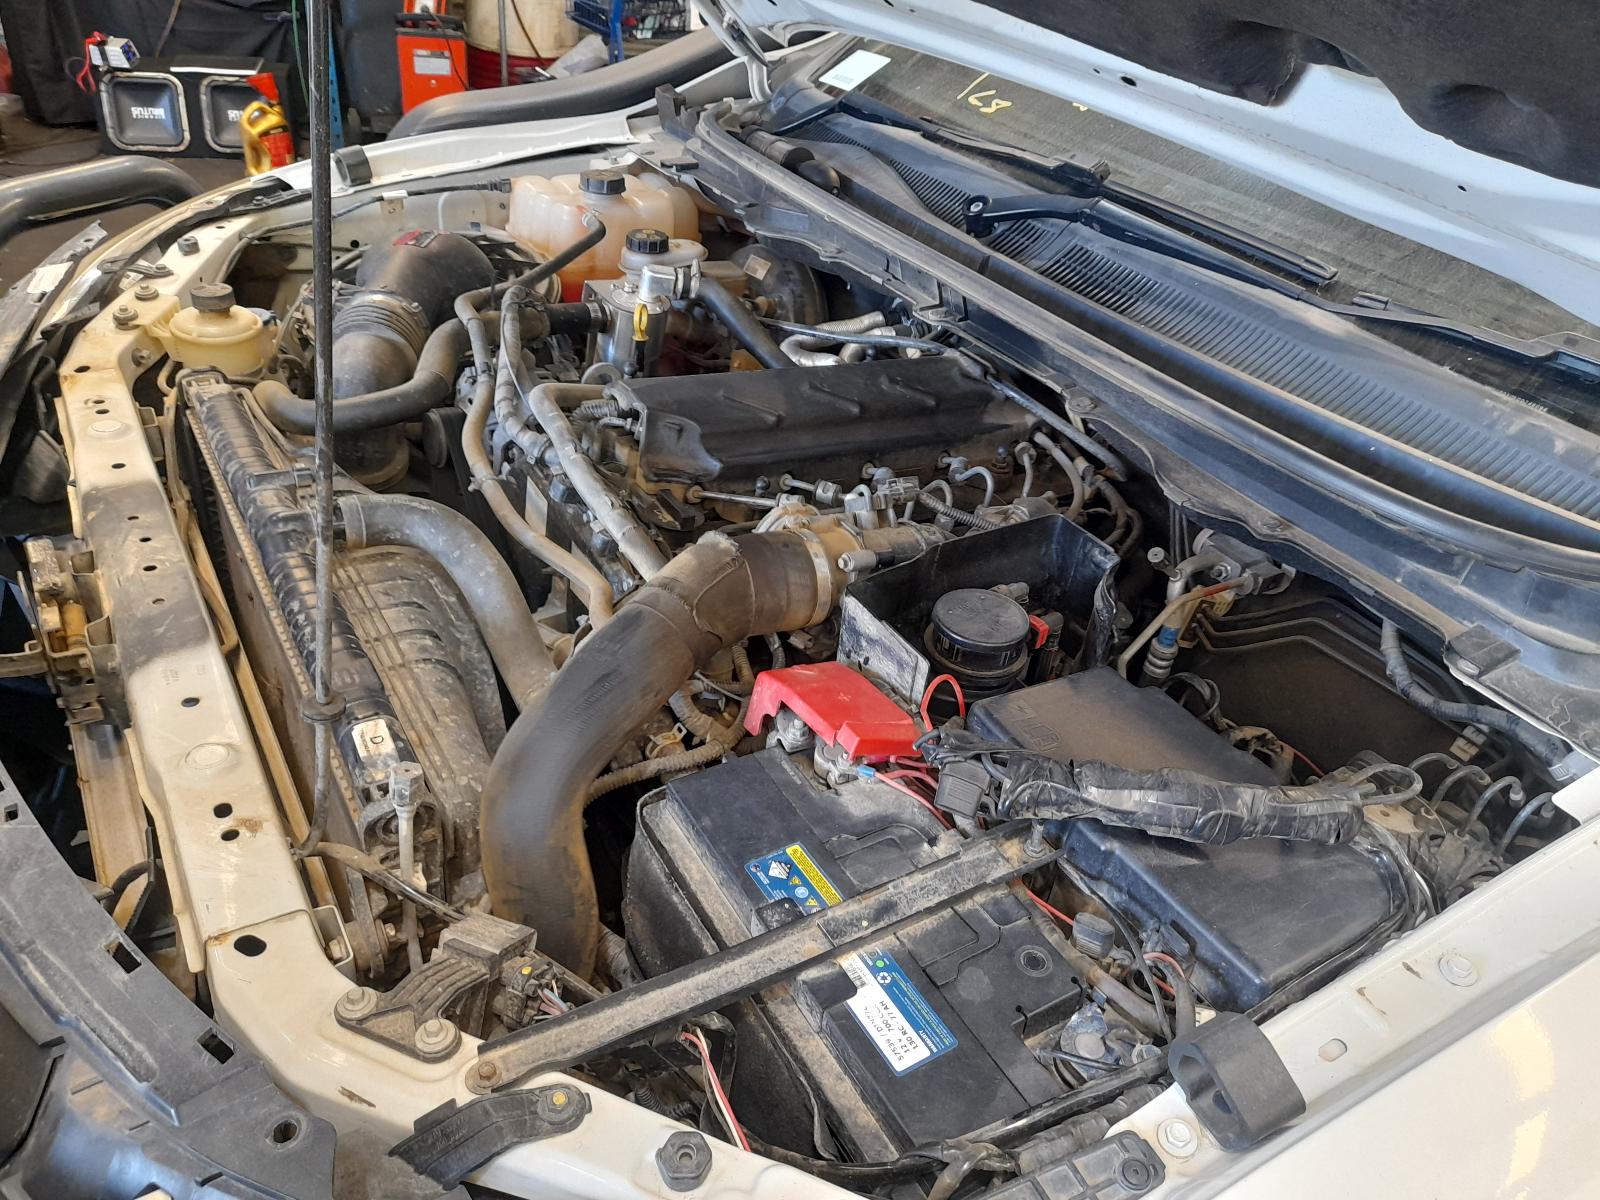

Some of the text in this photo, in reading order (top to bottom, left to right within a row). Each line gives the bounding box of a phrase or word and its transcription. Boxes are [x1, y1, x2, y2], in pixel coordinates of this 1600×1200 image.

[370, 735, 384, 744] D
[879, 1000, 890, 1011] AH
[881, 1019, 895, 1033] 700
[897, 1024, 908, 1036] RC
[900, 1043, 911, 1053] 12
[905, 1036, 919, 1050] 130
